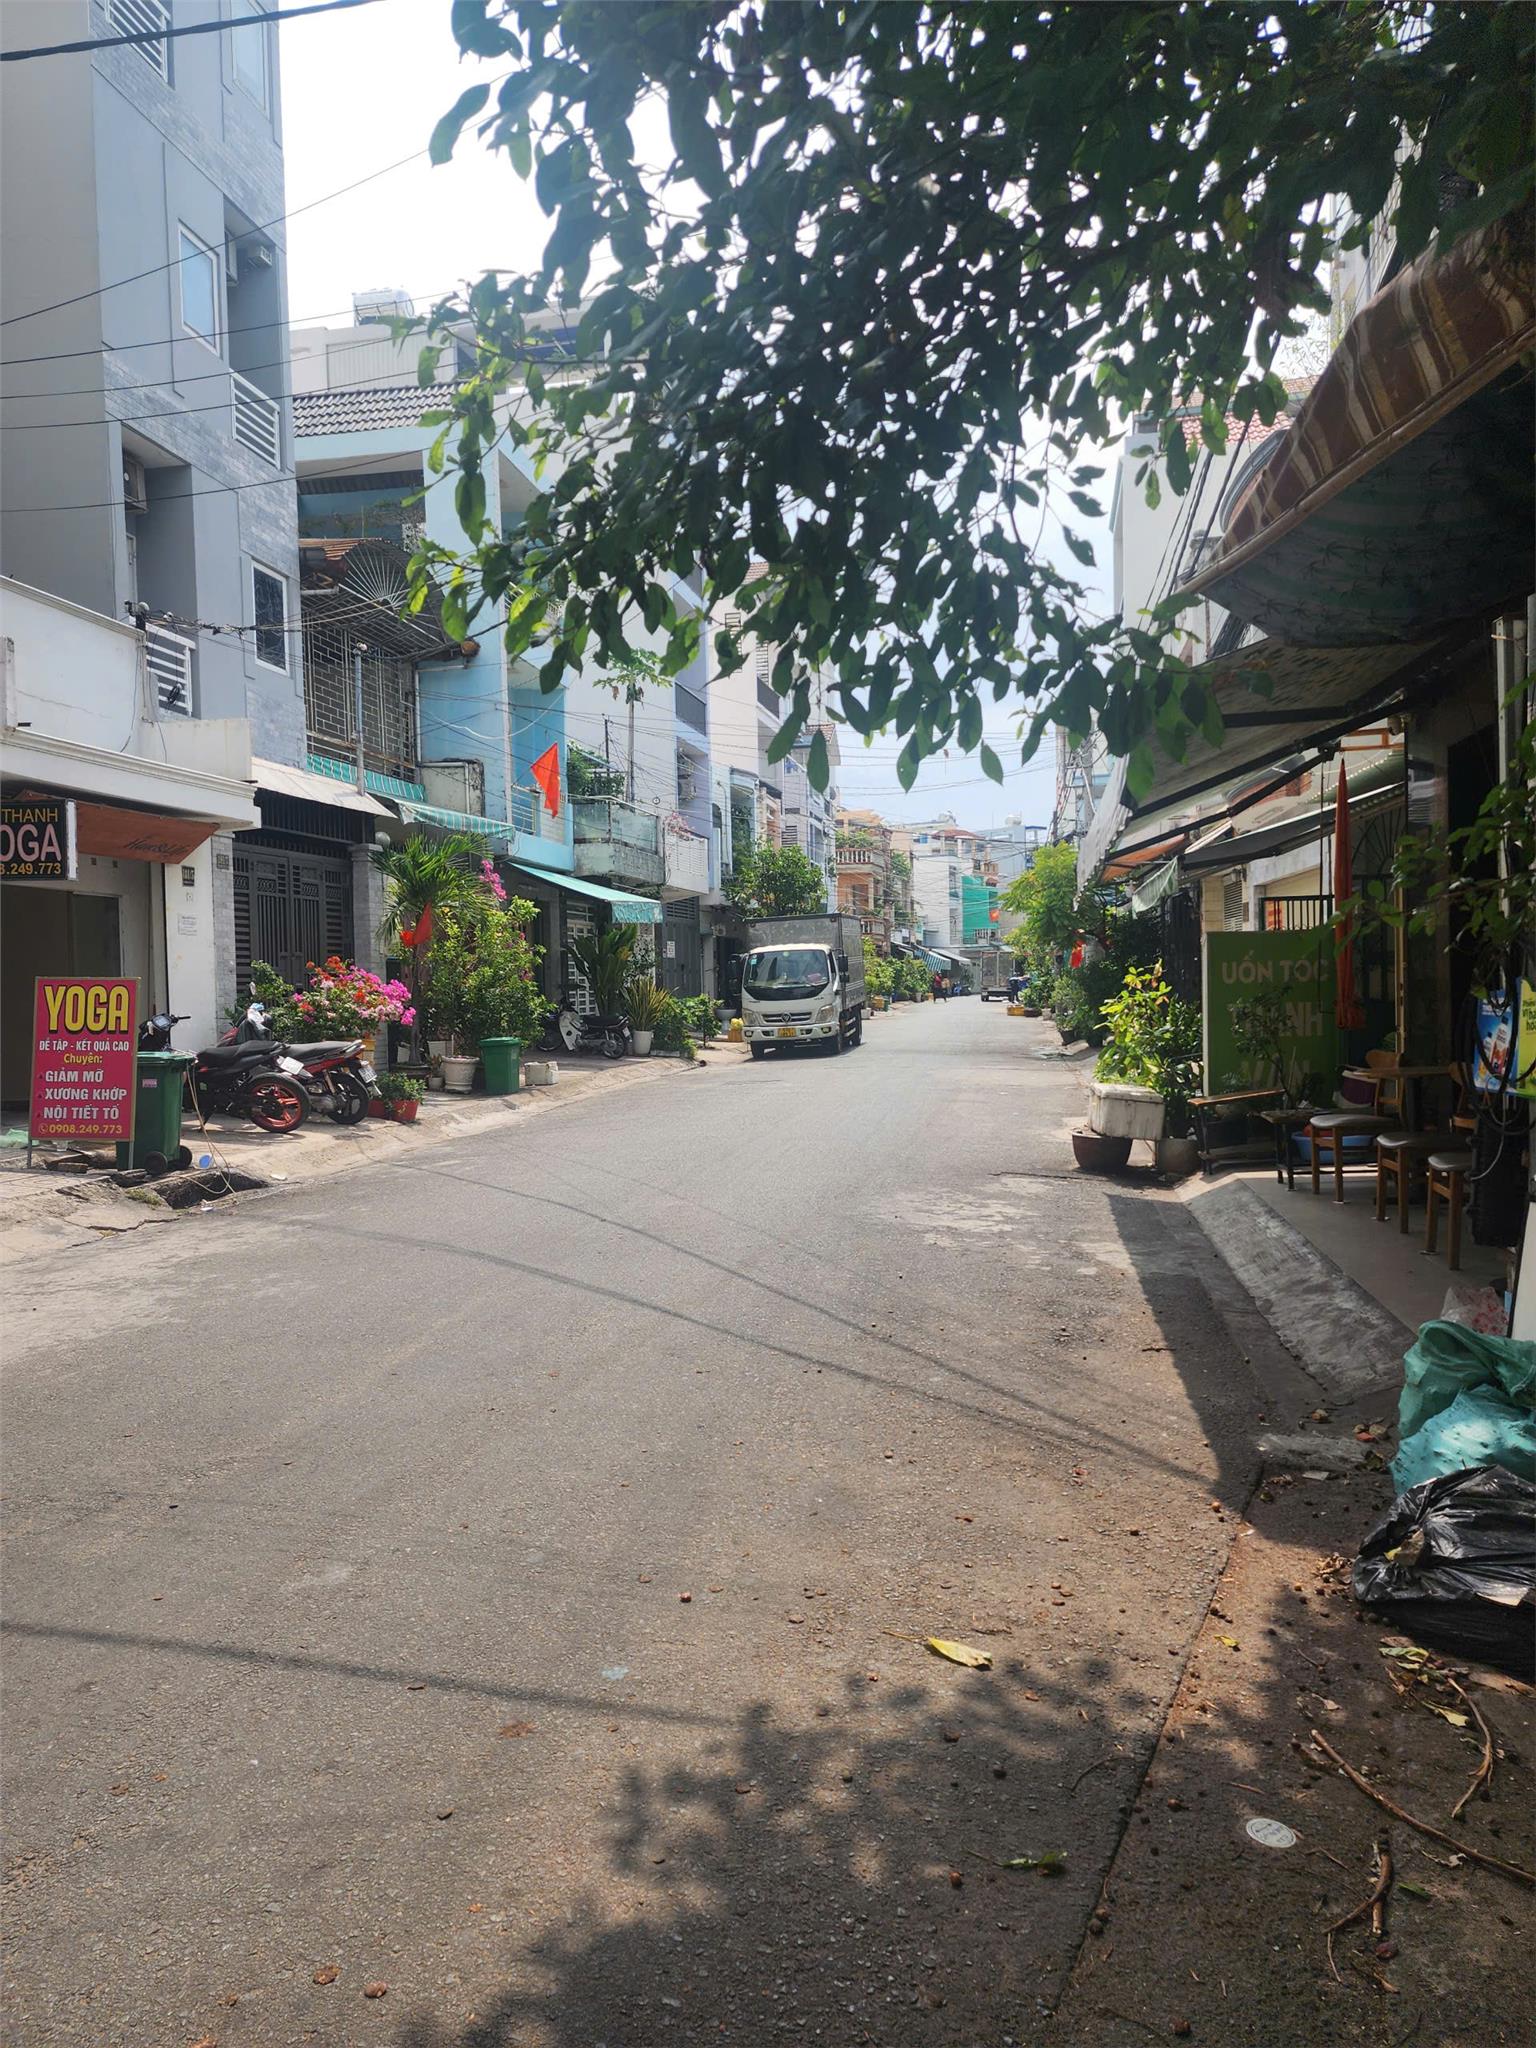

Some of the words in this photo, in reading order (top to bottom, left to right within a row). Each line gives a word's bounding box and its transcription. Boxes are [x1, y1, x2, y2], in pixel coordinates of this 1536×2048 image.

[1, 807, 58, 823] THANH
[1222, 949, 1273, 984] UỐN
[43, 984, 130, 1034] YOGA
[112, 1040, 130, 1051] CAO
[63, 1052, 103, 1065] Chuyên:
[45, 1066, 79, 1082] GIẢM
[45, 1086, 89, 1100] XƯƠNG
[92, 1086, 127, 1101] KHỚP
[43, 1104, 67, 1121] NỘI
[71, 1103, 99, 1119] TIẾT
[102, 1103, 120, 1120] TỐ
[49, 1124, 122, 1134] 0908.249.773
